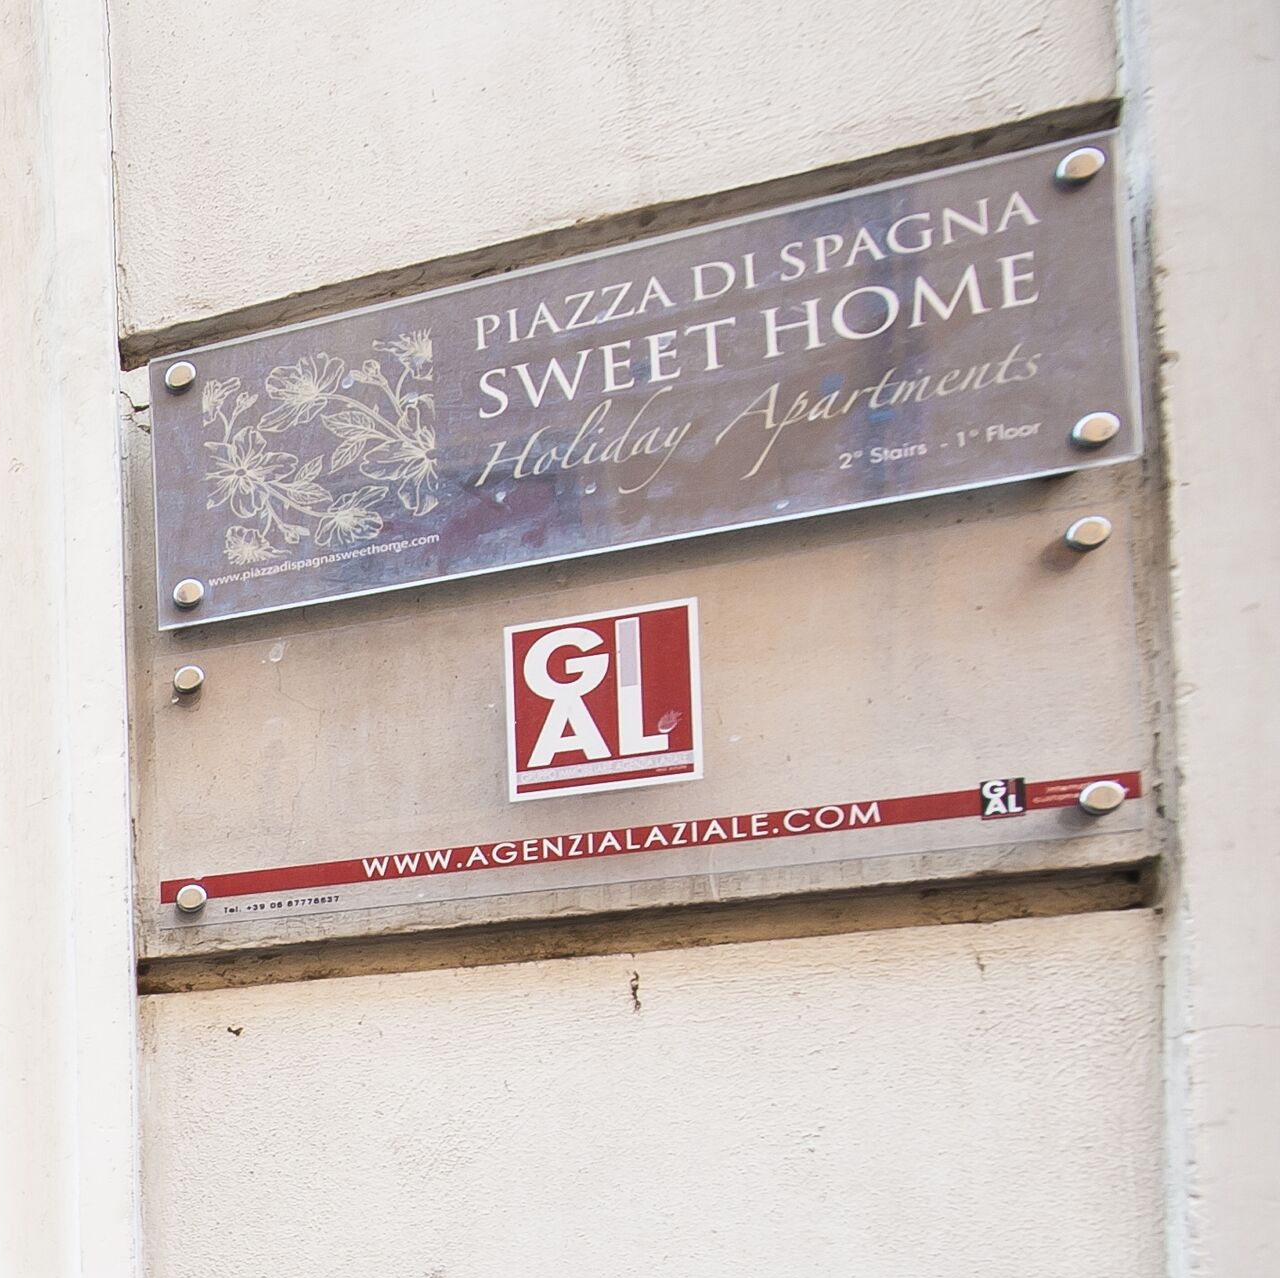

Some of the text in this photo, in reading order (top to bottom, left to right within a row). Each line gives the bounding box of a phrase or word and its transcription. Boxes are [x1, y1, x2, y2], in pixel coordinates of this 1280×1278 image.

[474, 191, 1040, 351] PIAZZA DI SPAGNA
[478, 251, 1040, 420] SWEET HOME
[474, 342, 1042, 494] Holiday Apartments
[869, 442, 928, 464] Stairs
[986, 421, 1043, 443] Floor
[208, 532, 441, 588] www.piazzadispagnasweethome.com
[362, 801, 883, 878] WWW.AGENZIALAZIALE.COM
[246, 902, 266, 912] +39
[269, 901, 283, 909] 06
